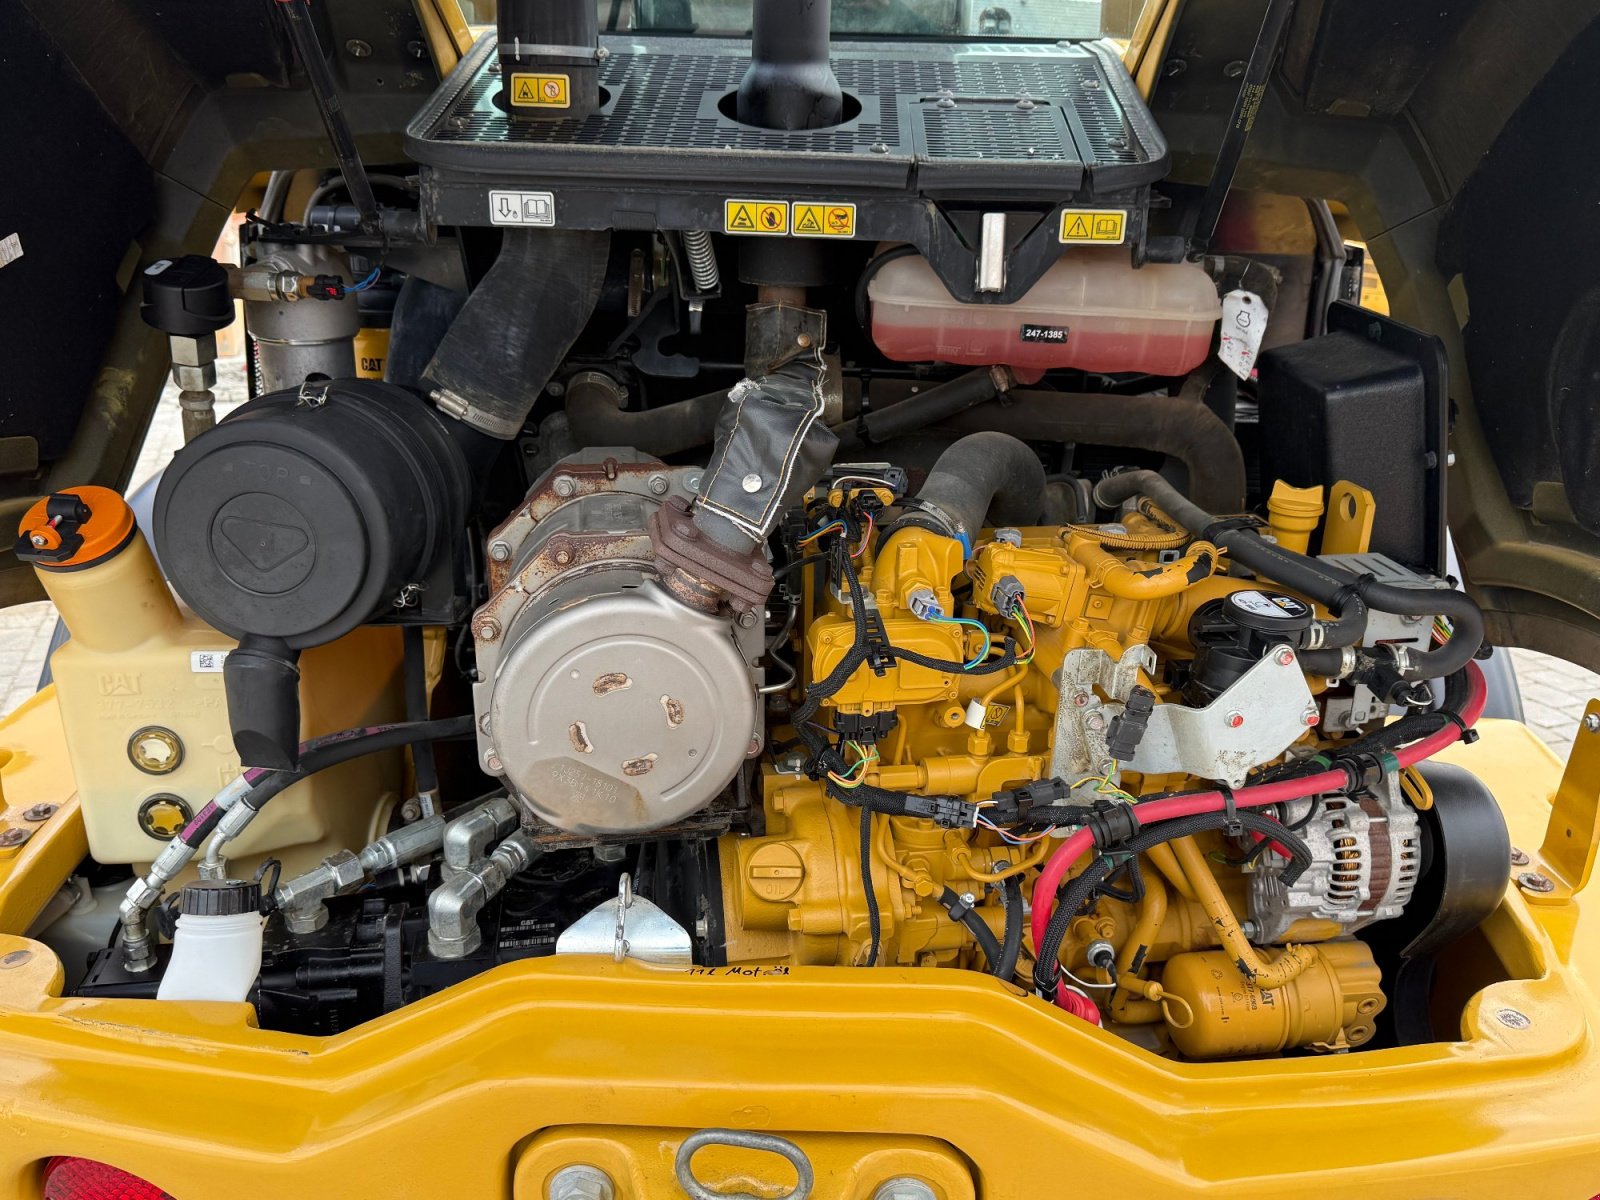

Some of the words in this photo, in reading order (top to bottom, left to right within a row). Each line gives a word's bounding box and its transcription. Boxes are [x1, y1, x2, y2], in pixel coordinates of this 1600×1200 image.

[1025, 328, 1063, 340] 247-1385
[361, 357, 383, 371] CAT
[1272, 597, 1302, 609] CAT
[97, 672, 142, 697] CAT
[765, 883, 785, 895] OIL
